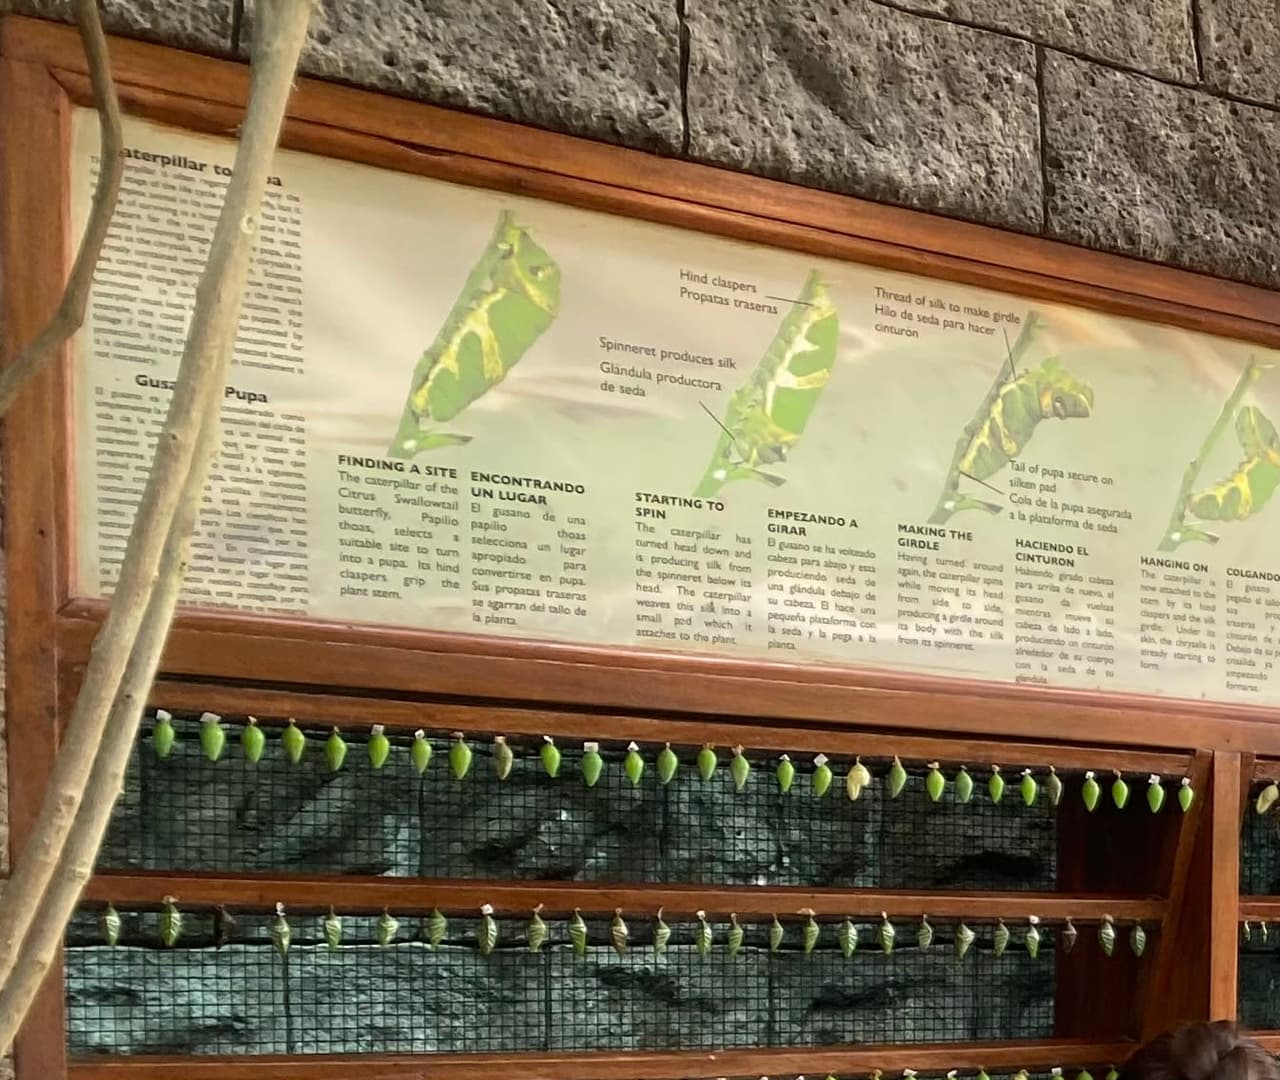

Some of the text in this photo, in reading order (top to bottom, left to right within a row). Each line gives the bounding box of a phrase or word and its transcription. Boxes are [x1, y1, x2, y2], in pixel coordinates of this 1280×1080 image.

[120, 148, 232, 176] aterpillar to
[680, 268, 757, 293] Hind claspers
[680, 286, 778, 314] Propatas traseras
[875, 286, 1020, 324] Thread of silk to make girdle
[875, 304, 995, 335] Hilo de seda para hacer
[600, 336, 736, 369] Spinneret produces silk
[600, 381, 645, 396] de seda
[656, 373, 721, 391] productora
[225, 386, 268, 403] Pupa
[338, 455, 457, 478] FINDING A SITE
[1009, 460, 1113, 485] Tail of pupa secure on
[338, 471, 458, 495] The caterpillar of the
[471, 472, 585, 494] ENCONTRANDO
[1009, 478, 1056, 493] silken pad
[338, 487, 458, 511] Citrus Swallowtail
[471, 487, 547, 505] UN LUGAR
[636, 492, 725, 511] STARTING TO
[471, 503, 586, 525] El gusano de una
[636, 507, 666, 519] SPIN
[1009, 493, 1132, 520] Cola de la pupa asegurada
[422, 512, 459, 526] Papilio
[768, 508, 858, 528] EMPEZANDO A
[1009, 511, 1118, 533] a la plataforma de seda
[394, 528, 433, 539] selects
[471, 521, 586, 540] papilio thoas
[636, 522, 752, 544] The caterpillar has
[768, 523, 806, 536] GIRAR
[898, 524, 973, 541] MAKING THE
[339, 538, 459, 557] suitable site to turn
[471, 535, 586, 557] selecciona un lugar
[636, 539, 752, 559] turned head down and
[898, 538, 940, 551] GIRDLE
[1016, 539, 1089, 556] HACIENDO EL
[339, 553, 362, 563] into
[418, 560, 430, 570] Its
[436, 562, 459, 573] hind
[472, 552, 586, 572] apropiado para
[1016, 552, 1075, 568] CINTURON
[1141, 556, 1208, 573] HANGING ON
[340, 569, 460, 589] claspers grip the
[472, 567, 532, 580] convertirse
[1226, 568, 1280, 582] COLGANDO
[340, 585, 368, 596] plant
[472, 581, 586, 600] Sus propatas traseras
[473, 599, 586, 616] se agarran del tallo de
[473, 613, 481, 622] la
